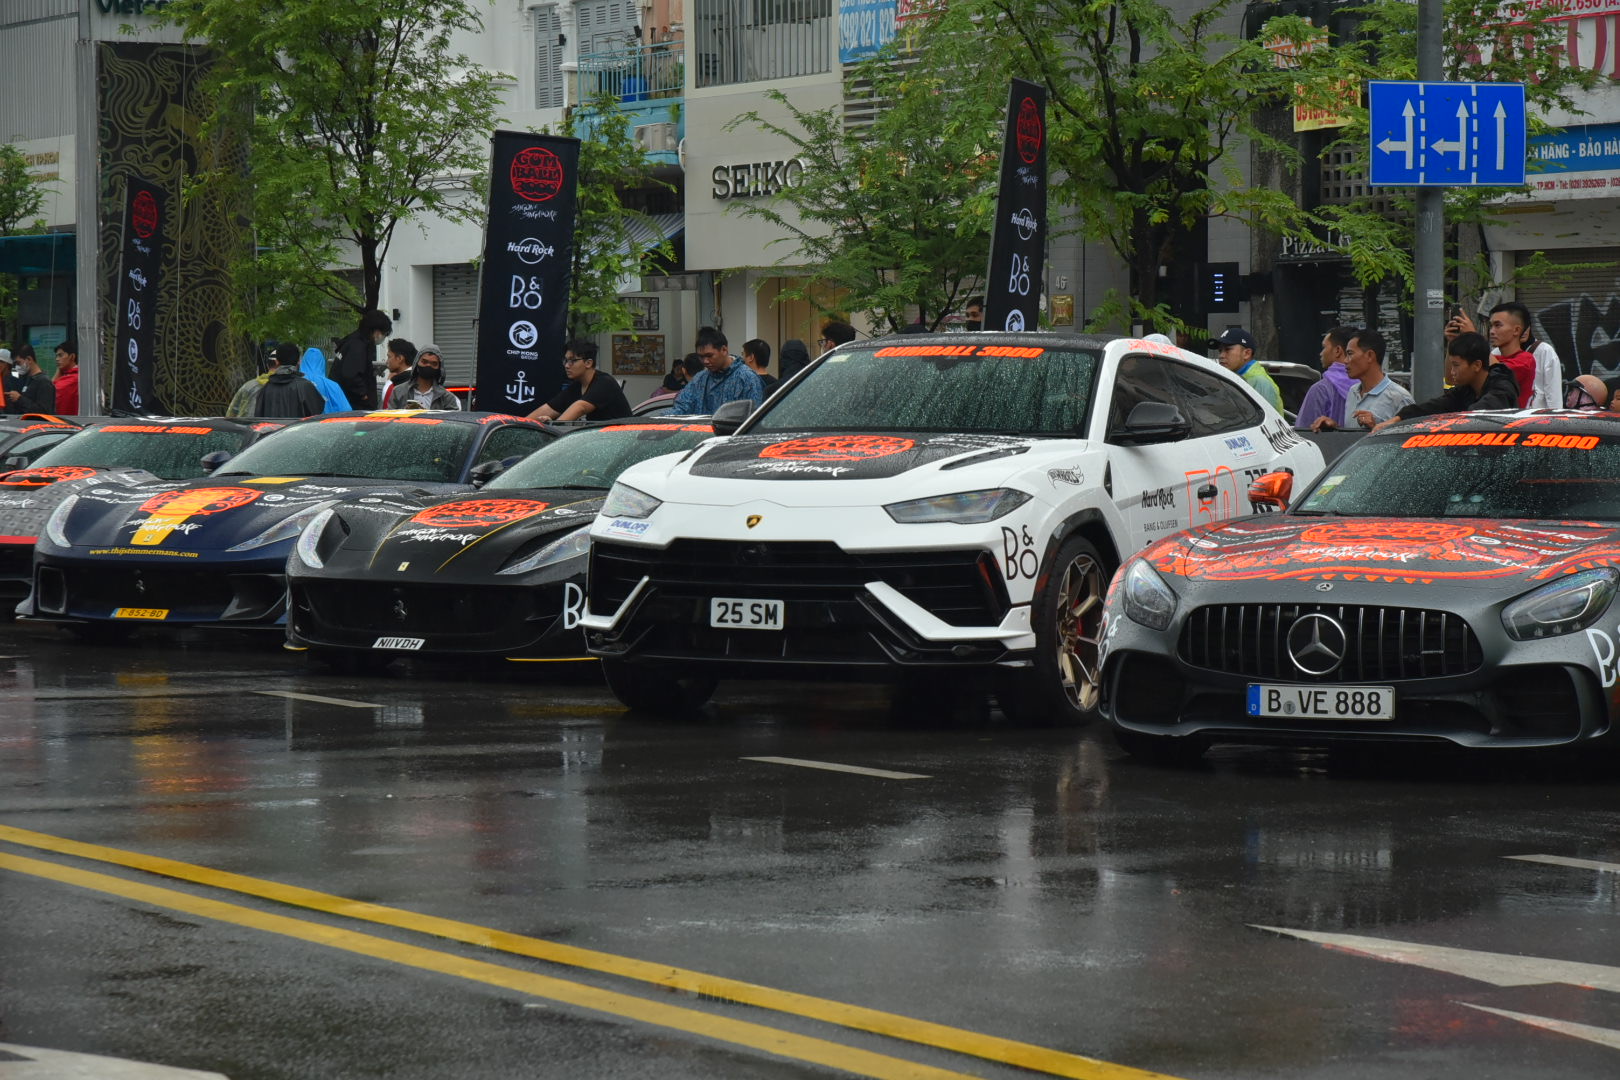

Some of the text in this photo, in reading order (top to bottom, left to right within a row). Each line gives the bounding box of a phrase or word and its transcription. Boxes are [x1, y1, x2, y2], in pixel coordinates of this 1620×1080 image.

[1541, 142, 1570, 159] HÃNG
[1579, 136, 1602, 157] BẢO
[712, 159, 804, 200] SEIKO
[507, 241, 554, 257] Hard Rock
[1280, 236, 1325, 256] Pizza
[874, 345, 1045, 359] GUMBALL 3000
[1401, 432, 1600, 450] GUMBALL 3000
[1141, 487, 1176, 510] Hard Rock
[119, 608, 164, 618] T-852-BD
[717, 602, 778, 625] 25 SM
[1268, 689, 1382, 716] B VE 888
